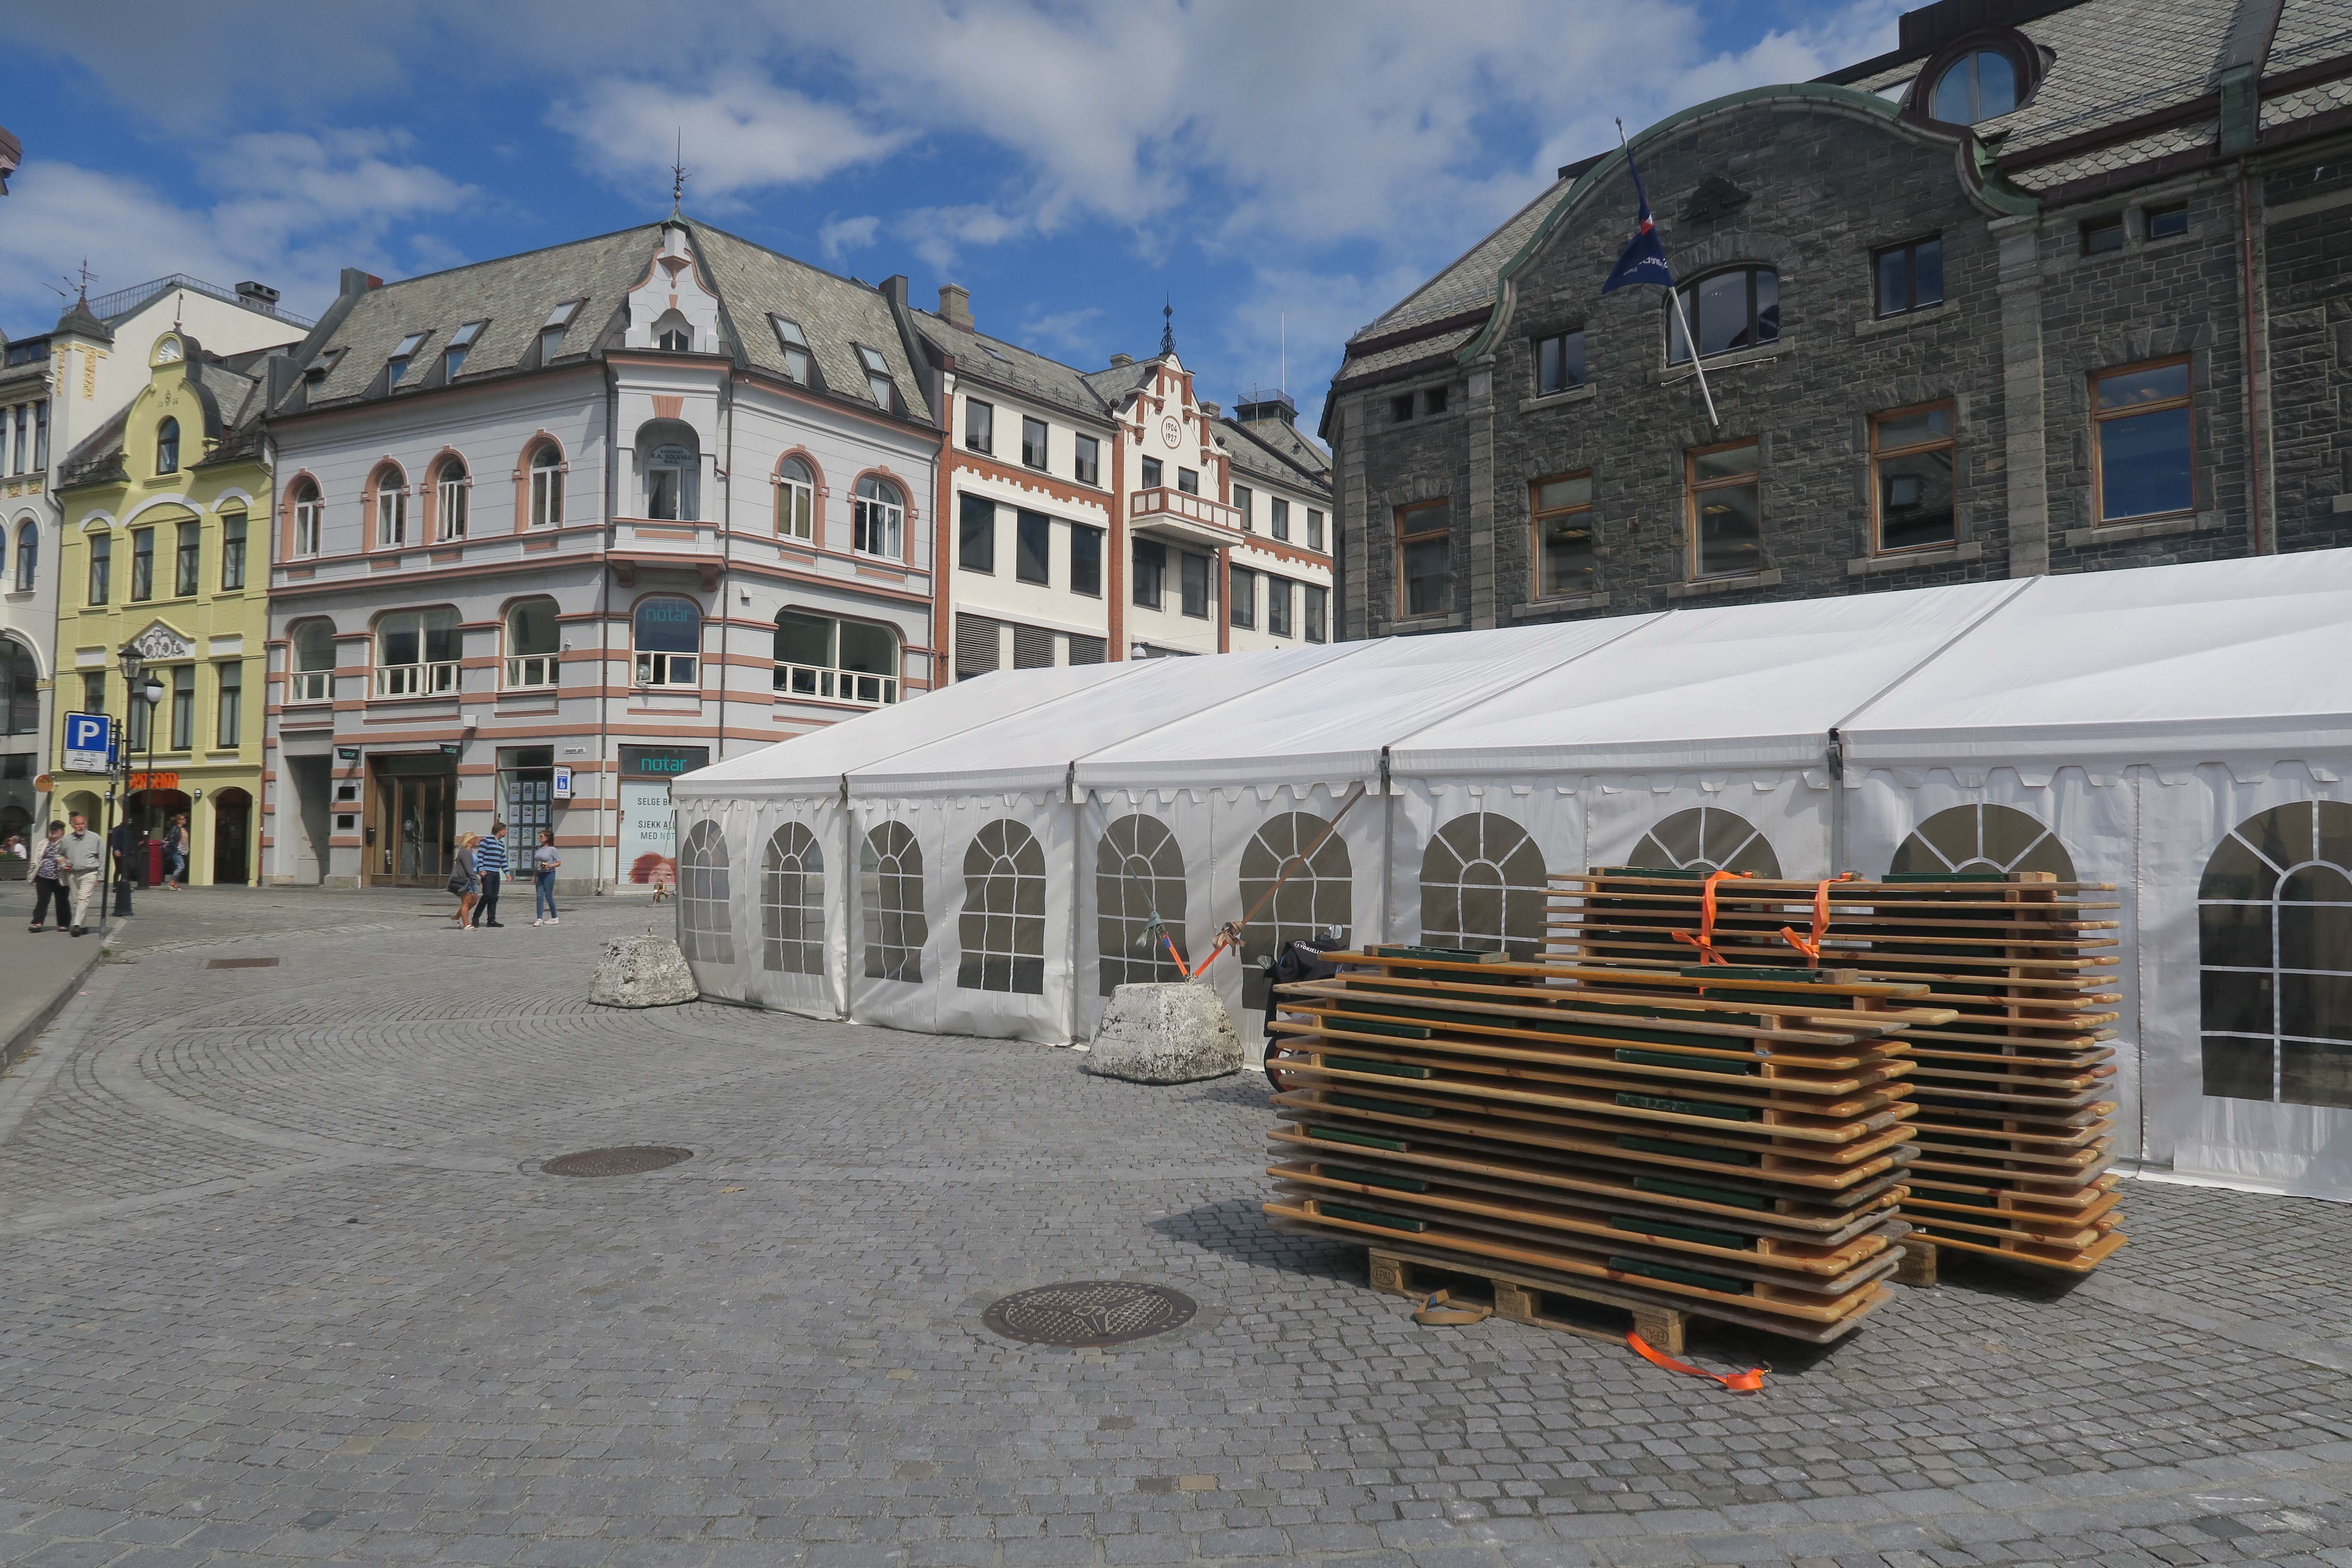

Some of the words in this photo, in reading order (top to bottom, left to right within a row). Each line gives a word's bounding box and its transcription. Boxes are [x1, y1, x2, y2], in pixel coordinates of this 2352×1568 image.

[1166, 422, 1177, 433] 1904
[1166, 432, 1177, 443] 1927
[646, 605, 691, 622] notar
[77, 720, 100, 747] P
[641, 755, 688, 772] notar
[1297, 943, 1326, 954] LYDKJELLE
[1375, 1269, 1392, 1283] EPAL
[1643, 1327, 1665, 1342] EPAL
